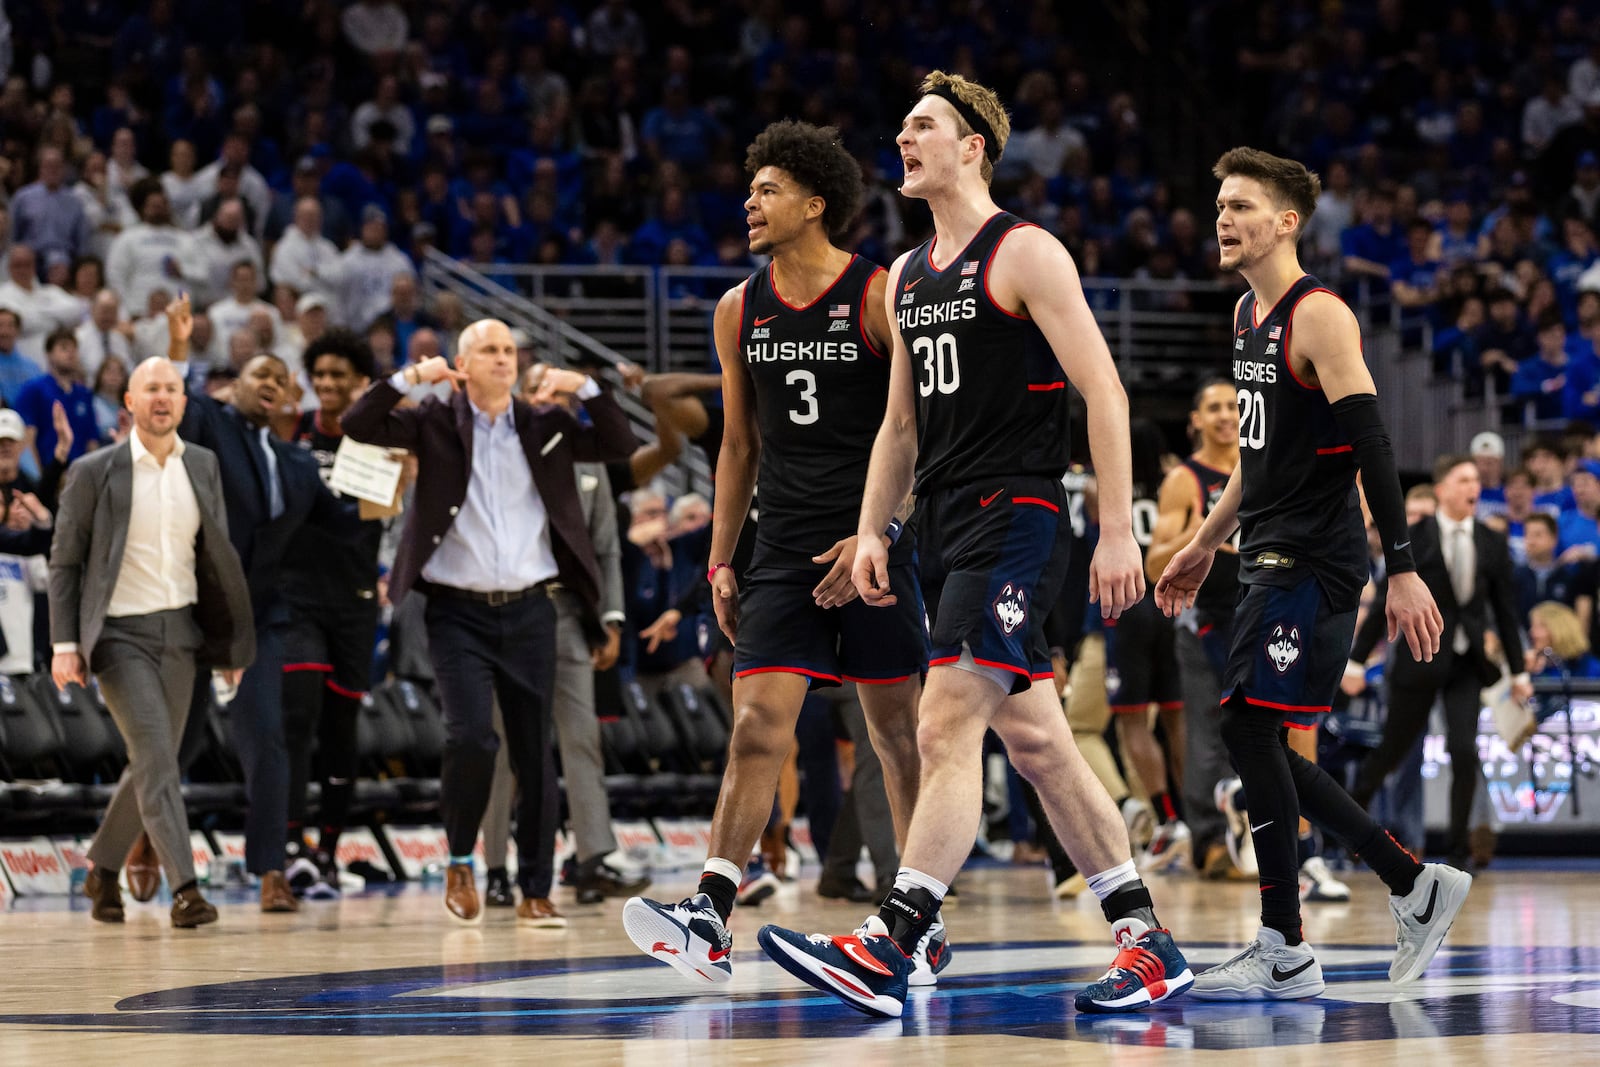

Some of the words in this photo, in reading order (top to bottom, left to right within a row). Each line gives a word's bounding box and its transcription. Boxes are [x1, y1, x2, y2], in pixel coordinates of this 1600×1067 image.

[897, 298, 976, 331] HUSKIES
[746, 342, 859, 363] HUSKIES
[912, 333, 960, 397] 30
[1233, 360, 1277, 384] HUSKIES
[785, 369, 819, 425] 3
[1237, 389, 1266, 450] 20
